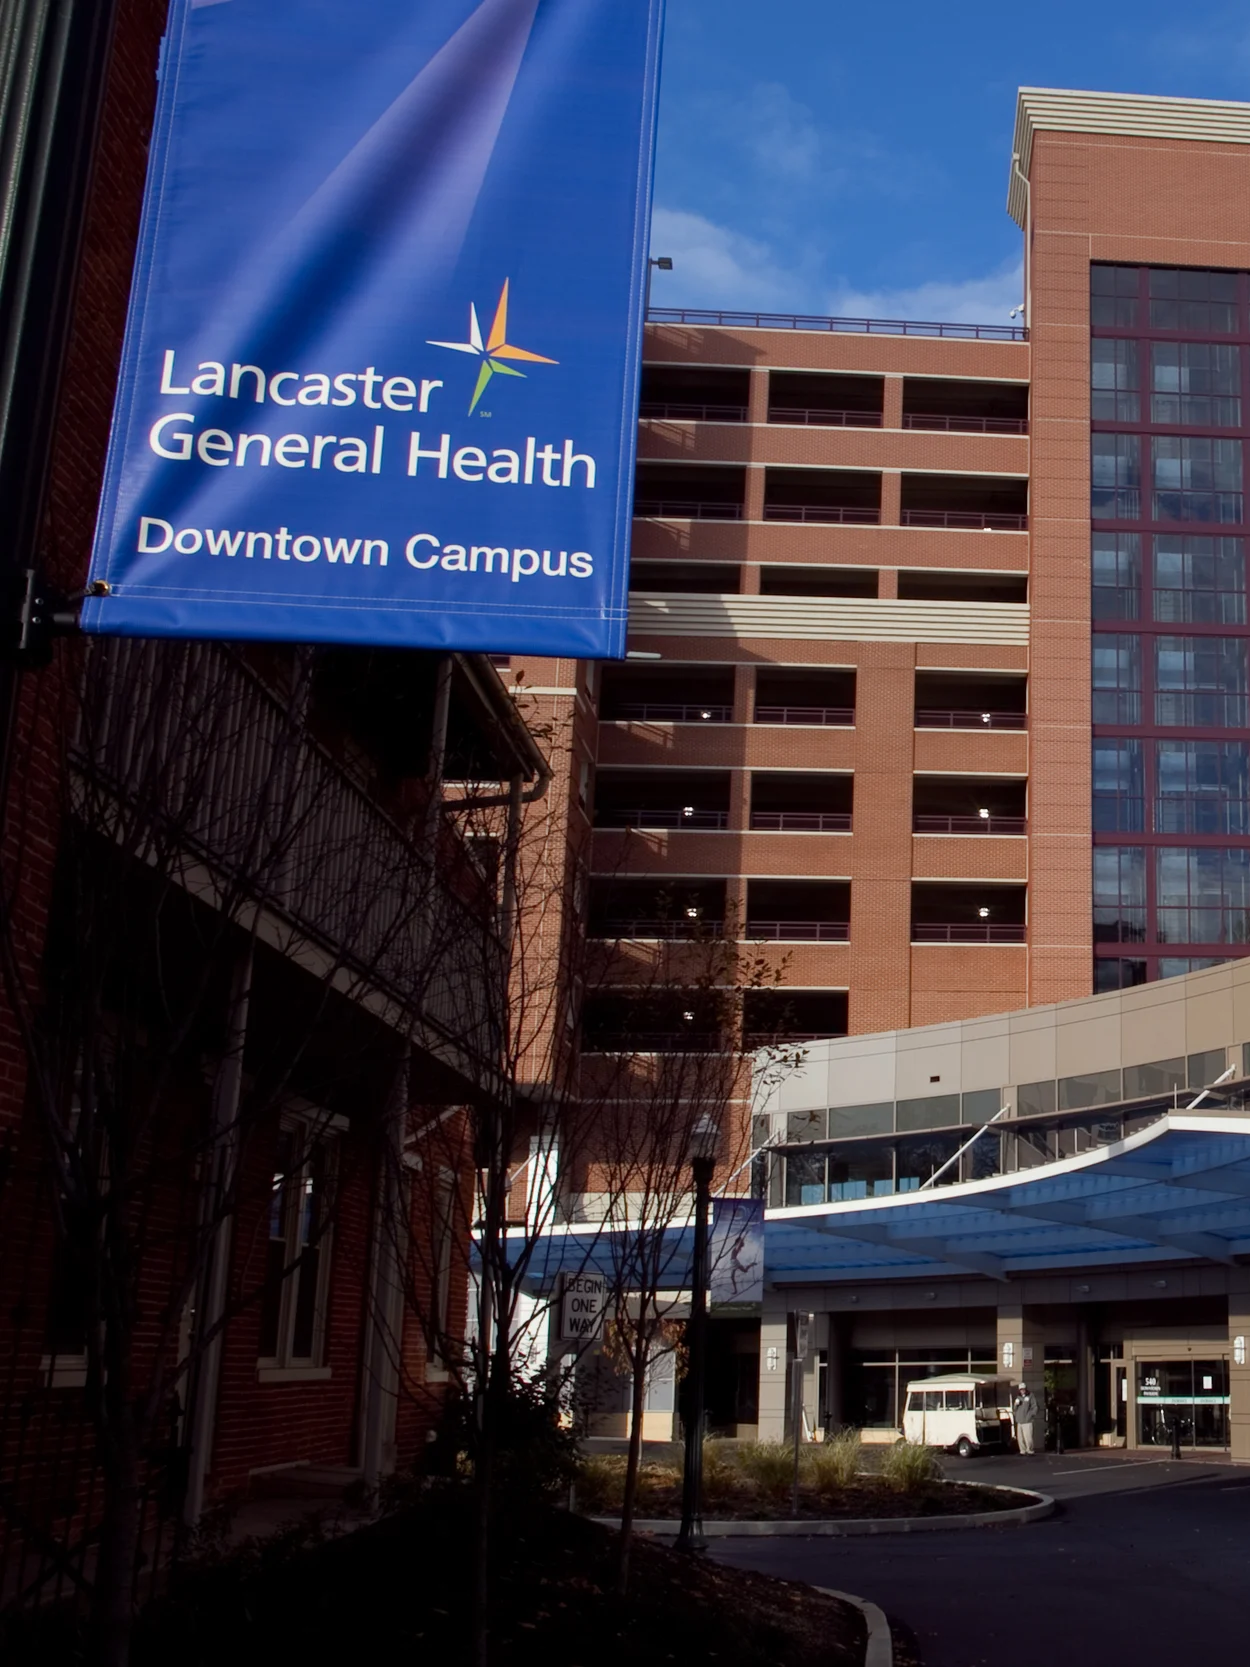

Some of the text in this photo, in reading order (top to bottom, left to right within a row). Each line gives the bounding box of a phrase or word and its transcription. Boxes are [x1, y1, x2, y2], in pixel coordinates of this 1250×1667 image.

[159, 350, 443, 413] Lancaster
[149, 412, 597, 490] General Health
[137, 516, 594, 582] Downtown Campus
[568, 1278, 602, 1294] BEGIN
[571, 1298, 597, 1313] ONE
[569, 1317, 596, 1333] WAY
